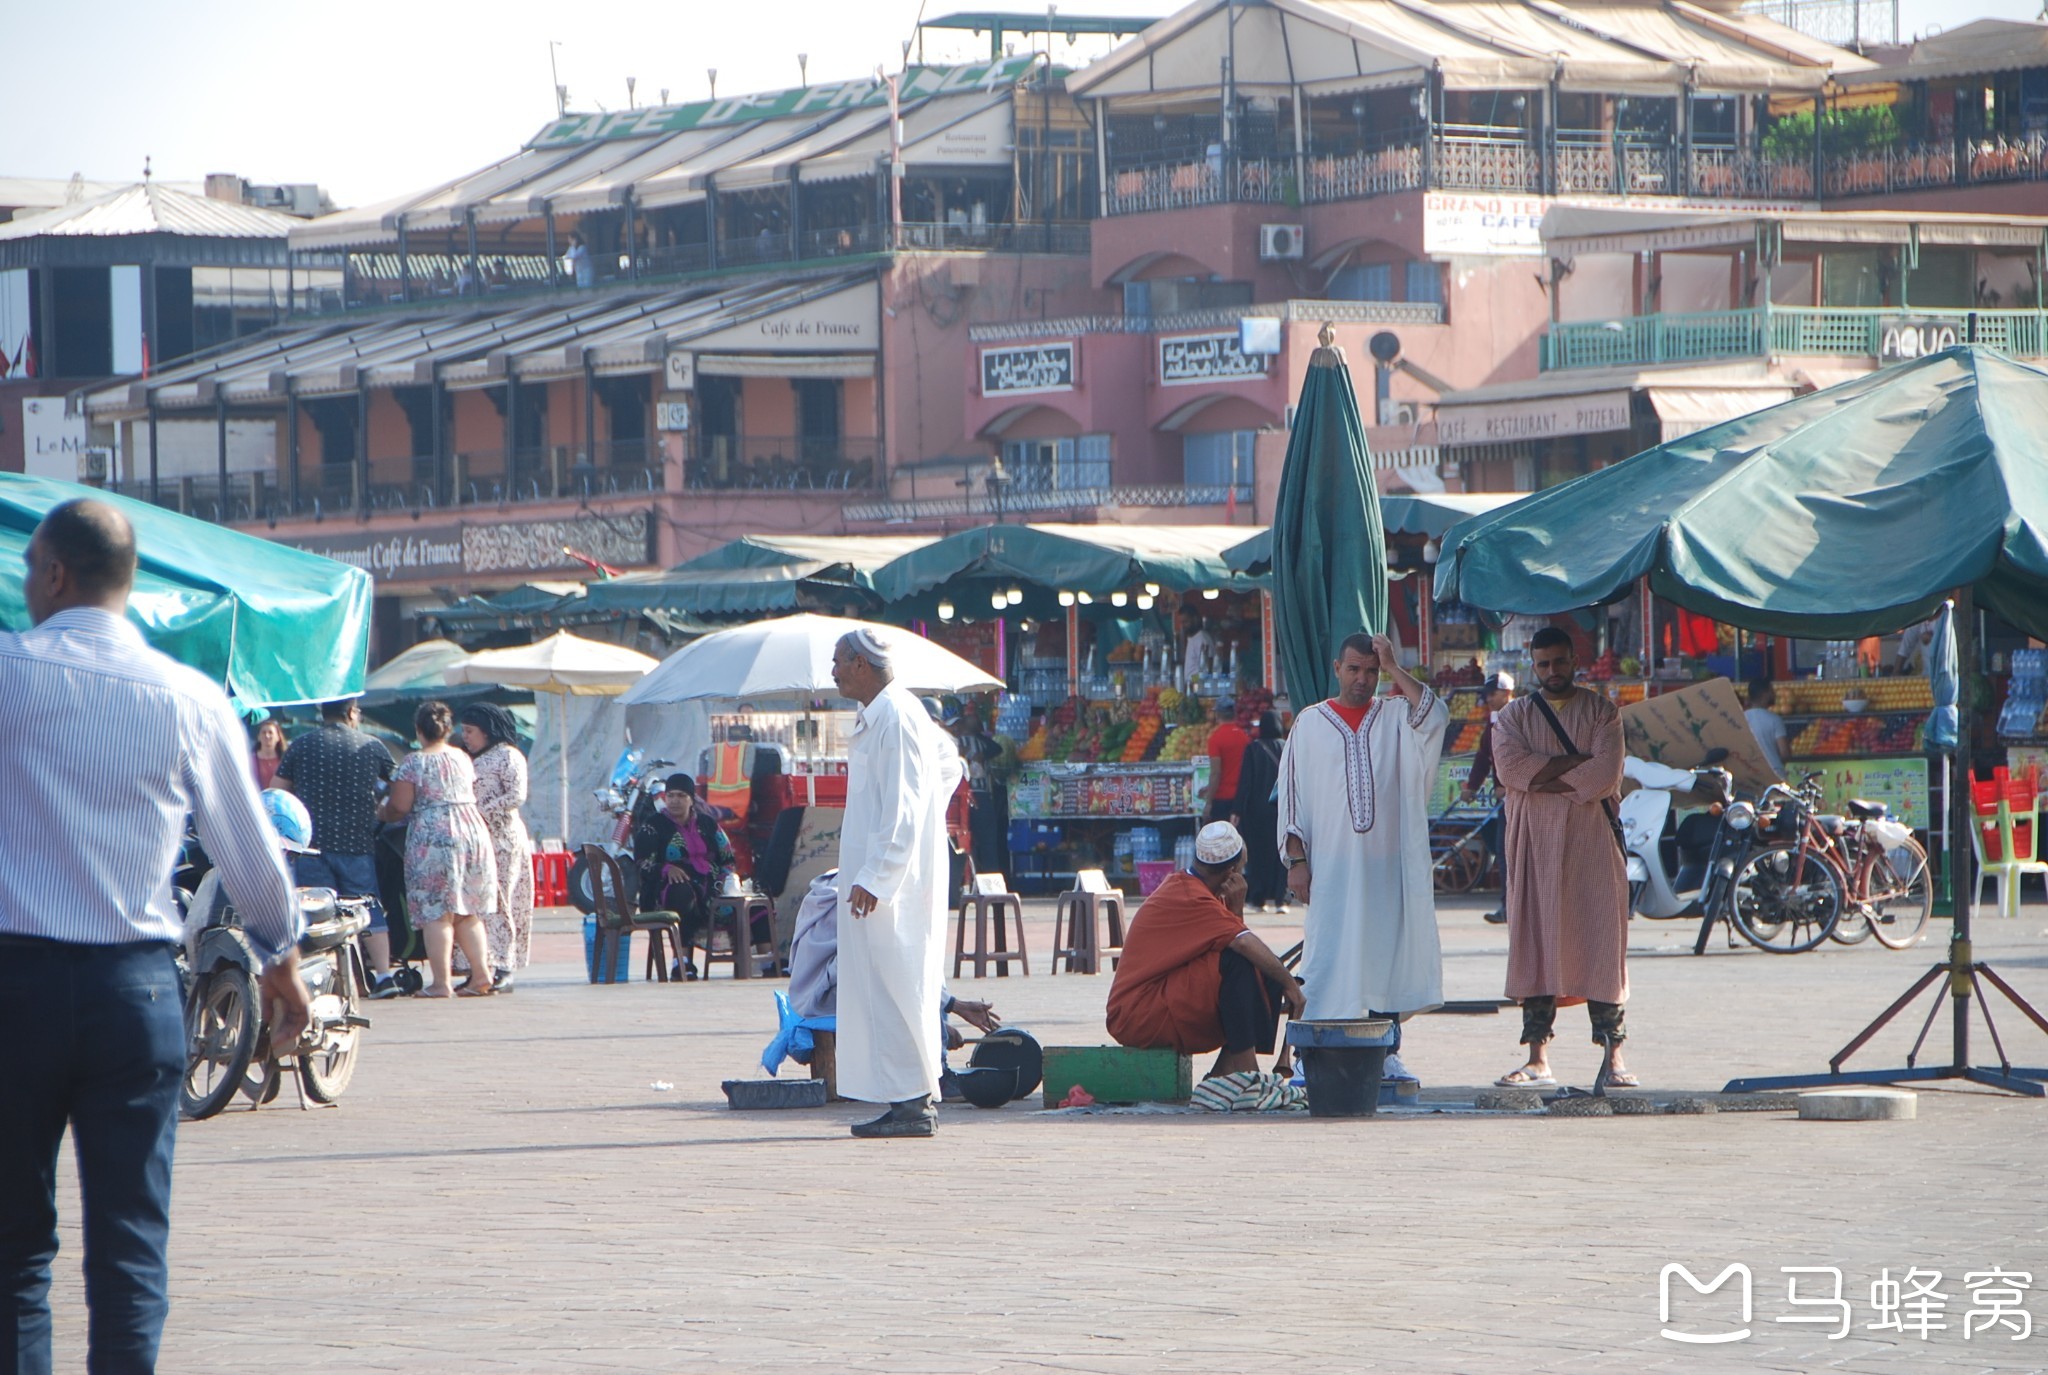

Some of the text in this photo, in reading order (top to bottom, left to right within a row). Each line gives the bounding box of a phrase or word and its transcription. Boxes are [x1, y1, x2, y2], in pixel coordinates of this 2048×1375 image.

[537, 104, 684, 145] CAFE
[1427, 196, 1502, 214] GRAND
[761, 320, 860, 340] Café de France
[1440, 406, 1628, 441] CAFÉ RESTAURANT PIZZERIA
[373, 536, 401, 579] Café
[403, 536, 418, 567] de
[420, 538, 461, 567] France
